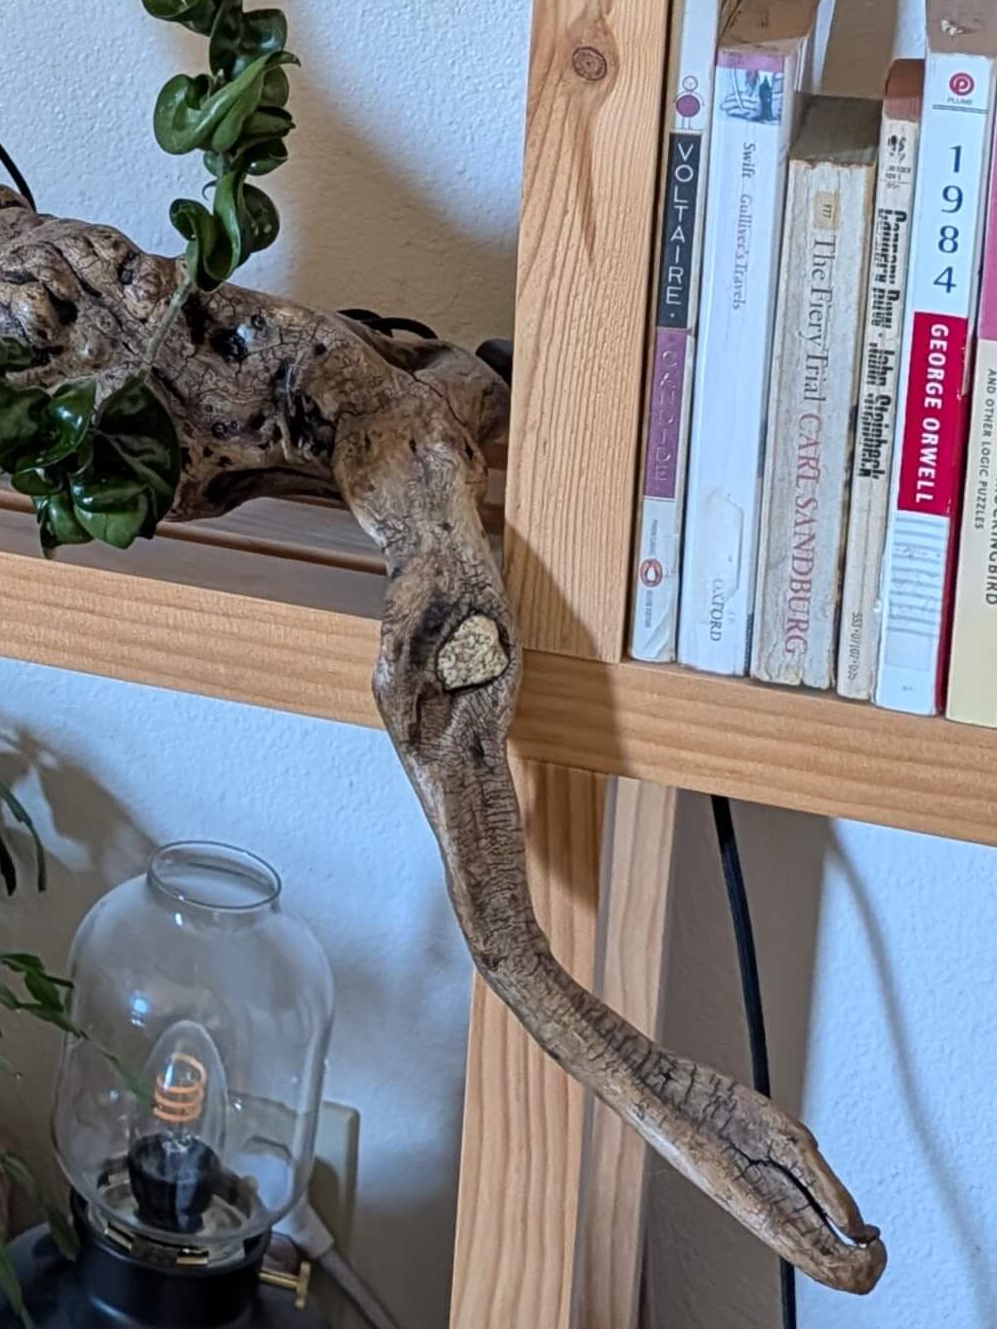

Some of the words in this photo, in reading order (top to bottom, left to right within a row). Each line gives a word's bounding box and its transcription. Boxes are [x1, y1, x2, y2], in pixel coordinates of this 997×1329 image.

[741, 142, 756, 179] Swift
[665, 142, 694, 305] VOLTAIRE
[735, 193, 753, 259] Gulliver's
[874, 207, 908, 285] Cannery
[811, 234, 837, 281] The
[732, 262, 748, 311] Travels
[871, 287, 901, 329] Row
[797, 287, 834, 347] Fiery
[803, 349, 829, 402] Trial
[866, 342, 896, 387] John
[923, 323, 949, 410] GEORGE
[985, 368, 997, 394] AND
[857, 392, 893, 480] Steinbeck
[982, 398, 995, 437] OTHER
[796, 413, 822, 489] CARL
[915, 417, 941, 503] ORWELL
[978, 441, 992, 476] LOGIC
[974, 480, 988, 530] PUZZLES
[783, 495, 819, 655] SANDBURG
